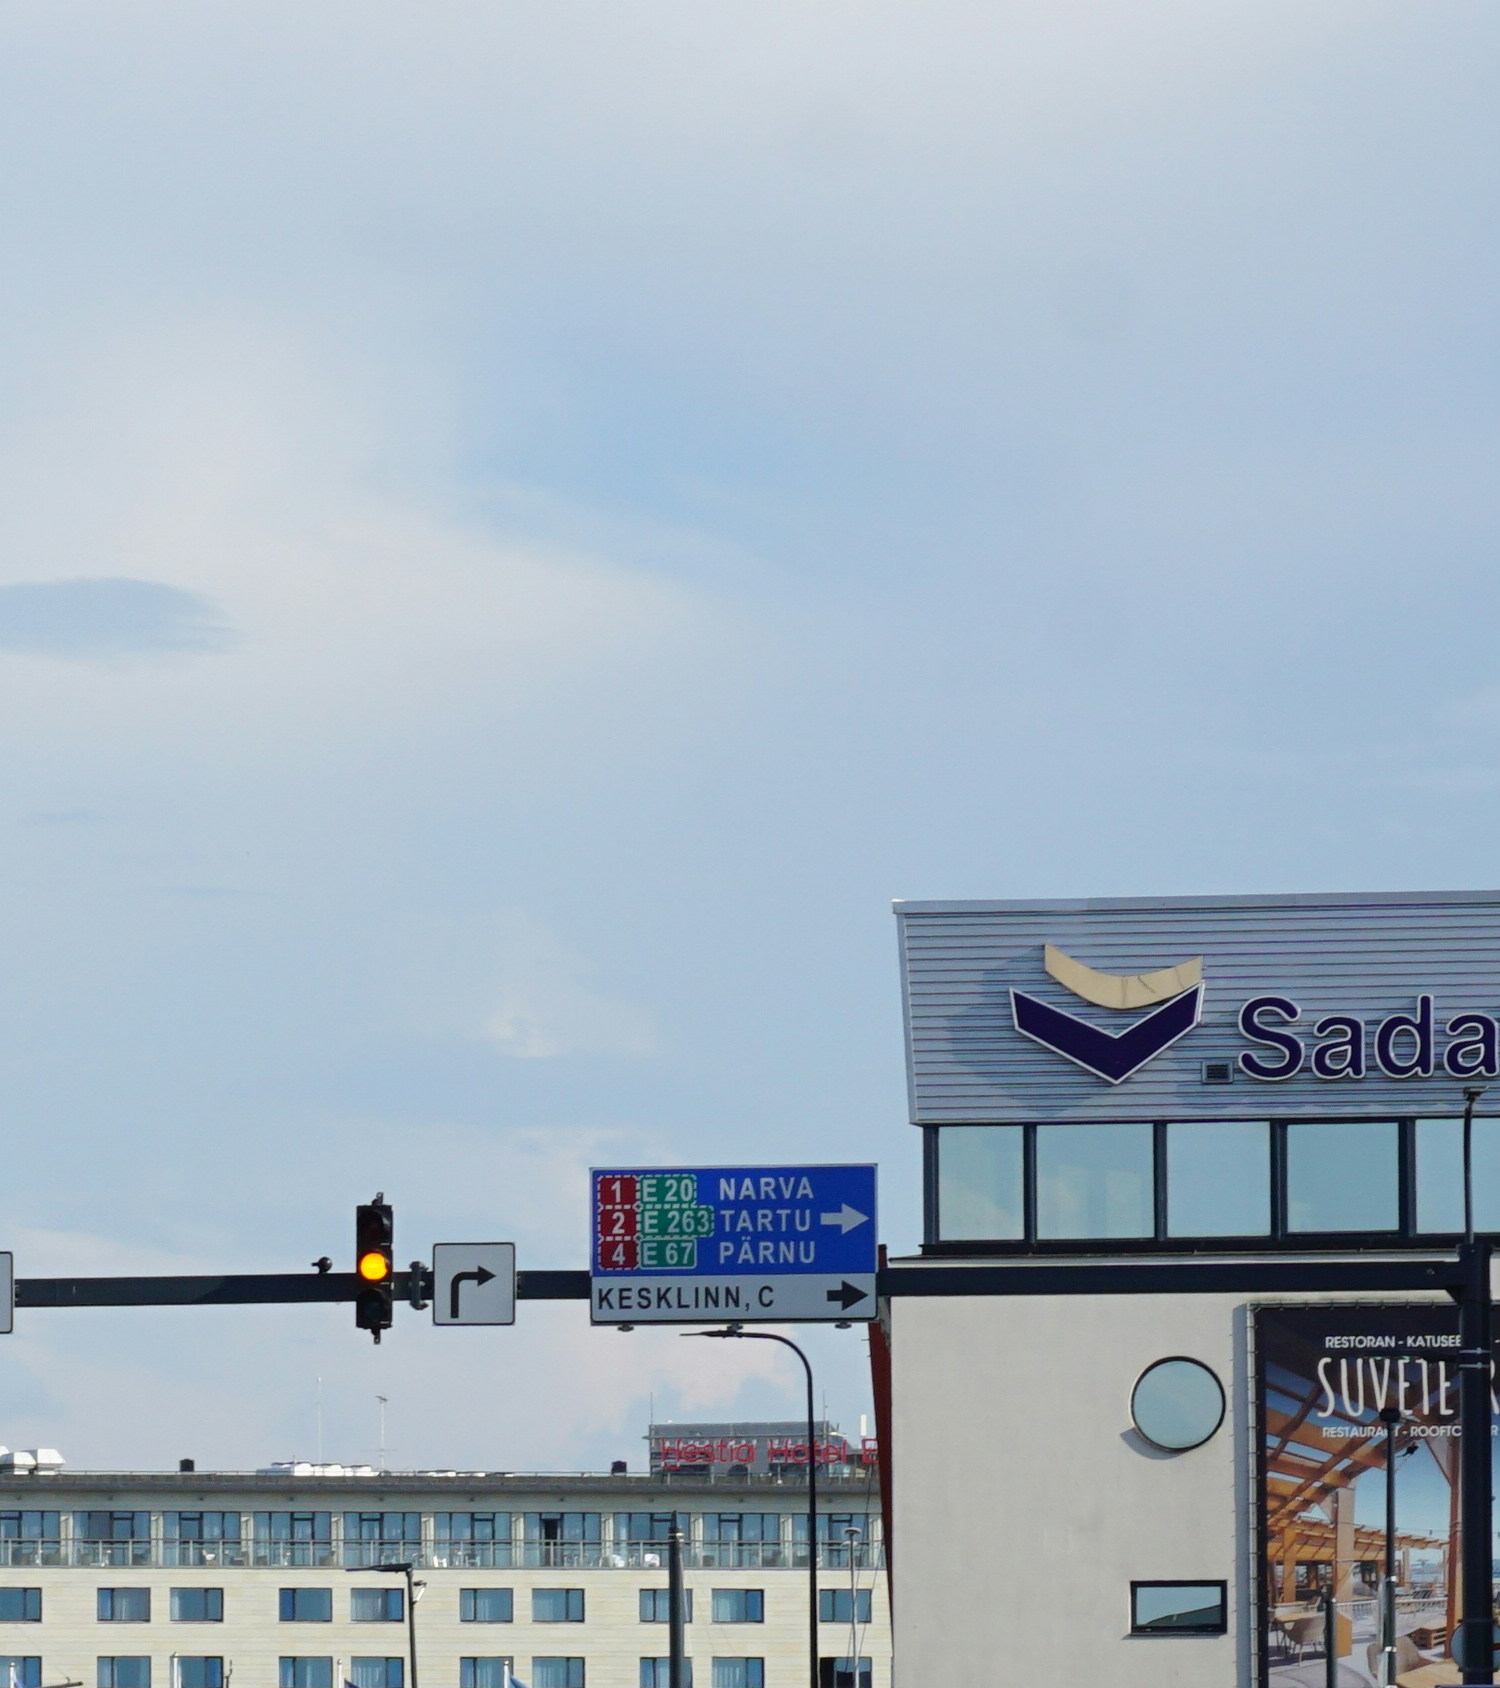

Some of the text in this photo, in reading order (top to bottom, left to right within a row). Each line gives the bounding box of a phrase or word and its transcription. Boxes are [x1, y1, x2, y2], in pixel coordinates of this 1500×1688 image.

[610, 1176, 814, 1203] 1 E 20 NARVA
[611, 1209, 811, 1235] 2 E 263 TARTU
[611, 1236, 816, 1265] 4 E 67 PÄRNU
[598, 1285, 775, 1311] KESKLINN, C
[1325, 1335, 1396, 1349] RESTORAN
[659, 1437, 757, 1465] Hestia
[769, 1437, 849, 1465] Hotel
